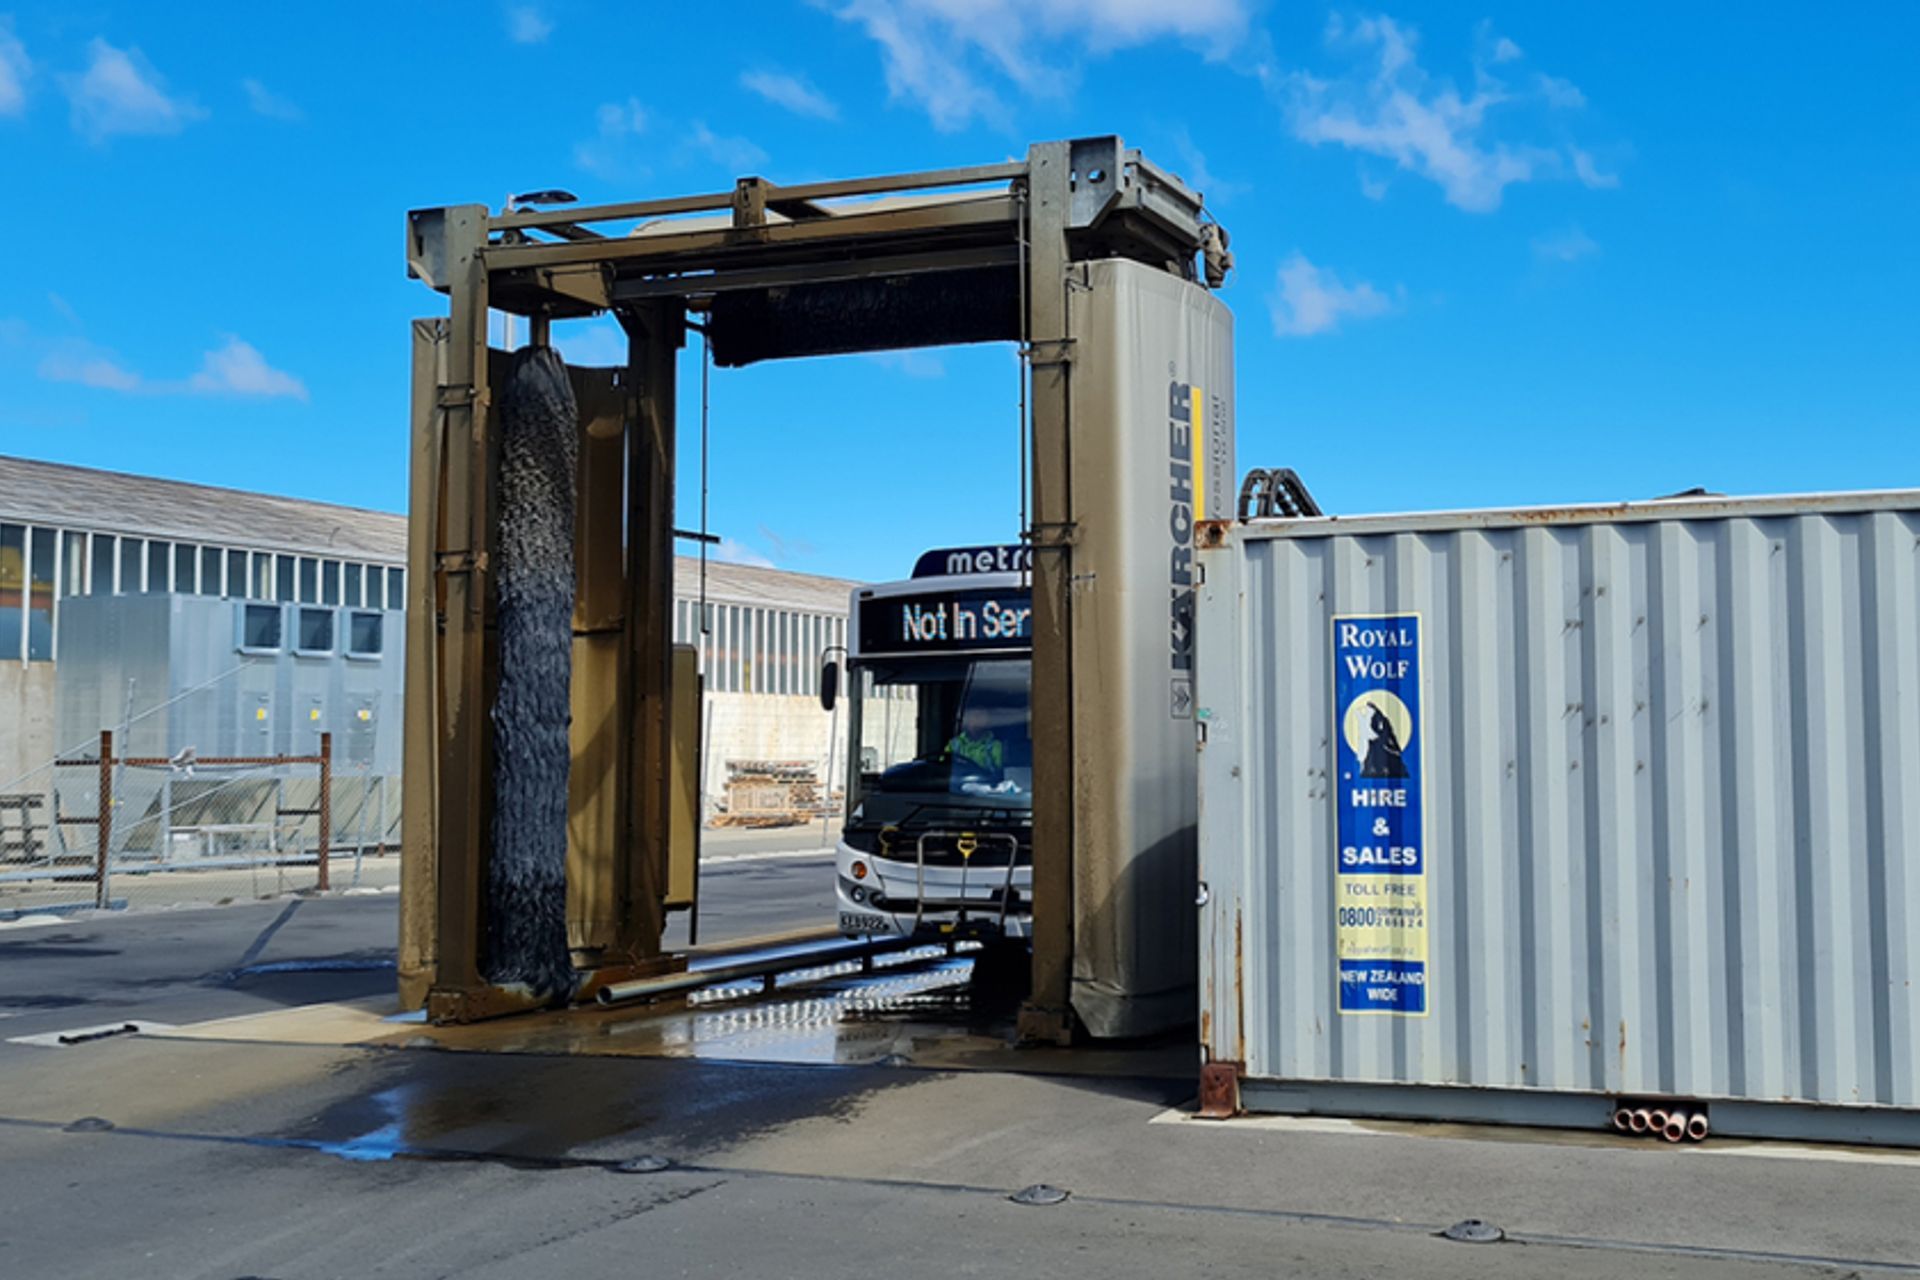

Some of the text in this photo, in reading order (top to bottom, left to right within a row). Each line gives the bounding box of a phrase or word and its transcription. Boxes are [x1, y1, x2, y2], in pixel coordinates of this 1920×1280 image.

[903, 601, 1031, 641] Not In Ser
[1340, 624, 1413, 648] ROYAL
[1345, 655, 1409, 679] WOLF
[1352, 789, 1407, 807] HIRE
[1372, 817, 1390, 836] &
[1343, 847, 1418, 866] SALES
[1346, 883, 1416, 897] TOLL FREE
[1339, 906, 1375, 928] 0800
[1340, 970, 1424, 985] NEW ZEALAND
